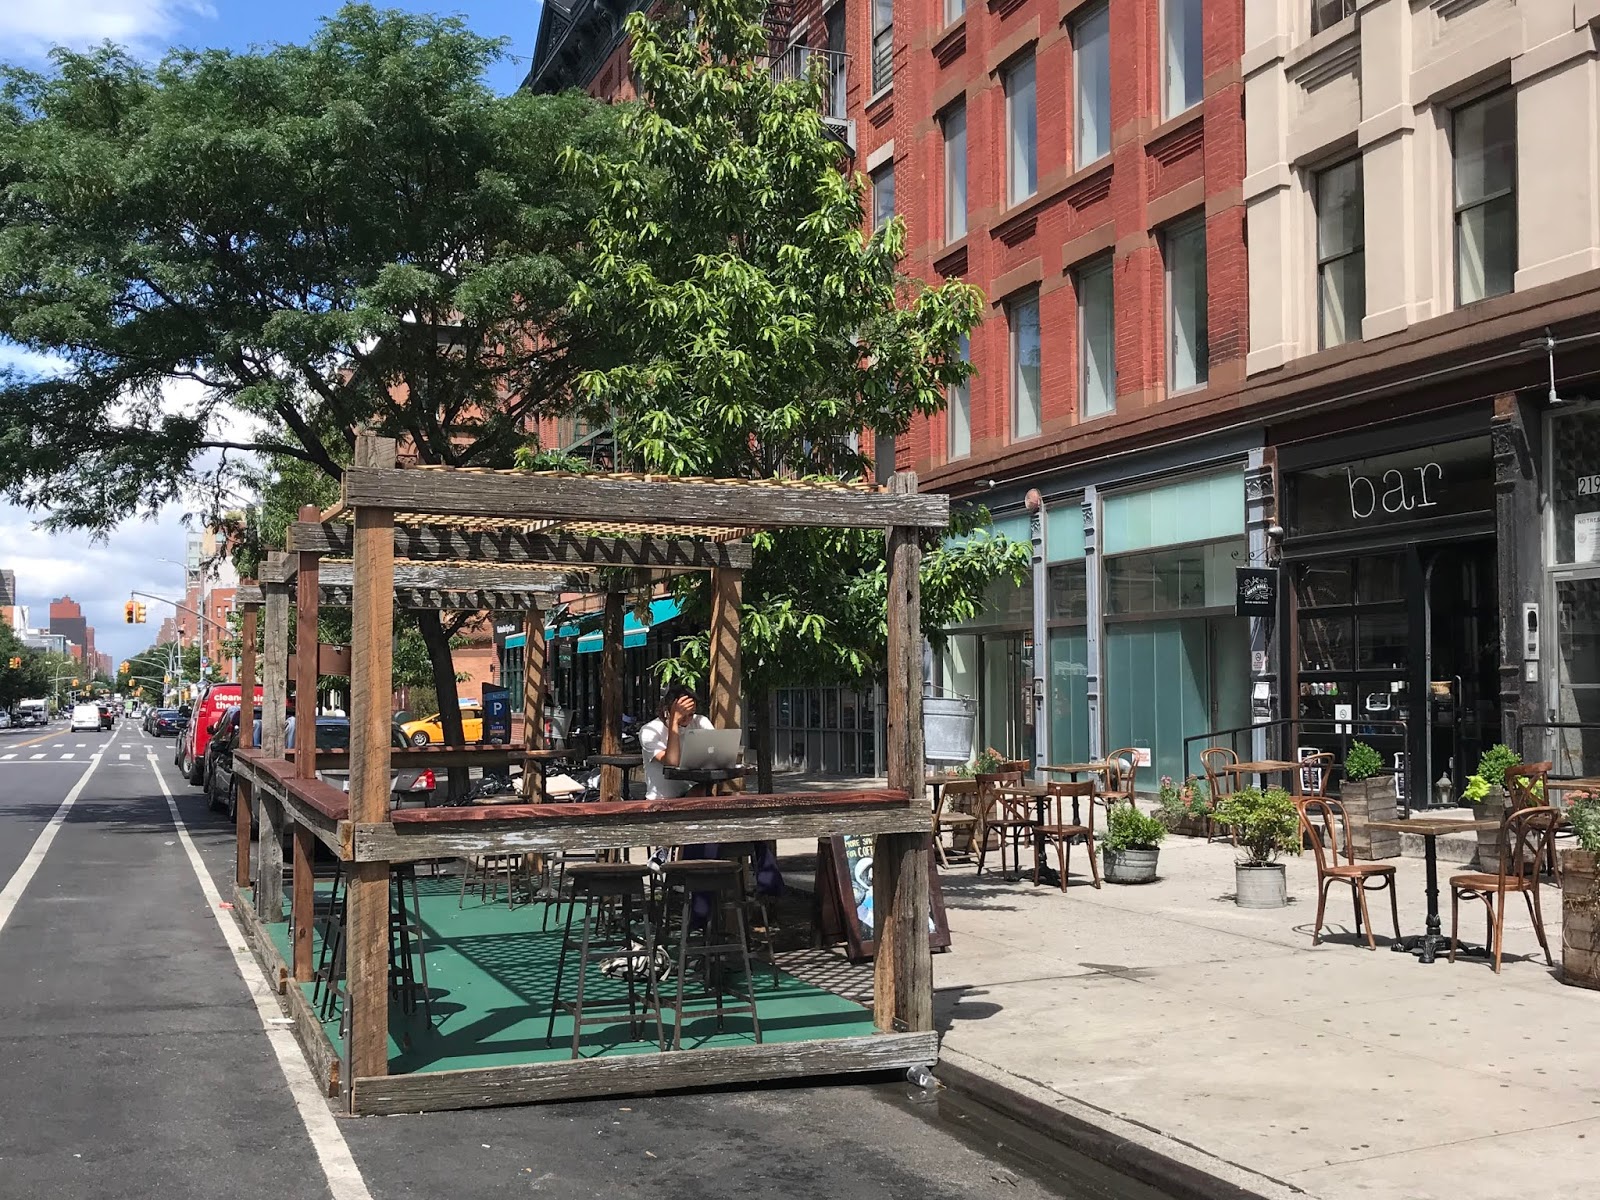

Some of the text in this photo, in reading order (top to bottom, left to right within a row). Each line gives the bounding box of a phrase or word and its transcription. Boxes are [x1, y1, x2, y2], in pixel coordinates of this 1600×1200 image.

[1342, 463, 1442, 519] bar
[493, 702, 502, 715] P
[845, 839, 860, 848] MORE
[846, 849, 857, 858] FOR
